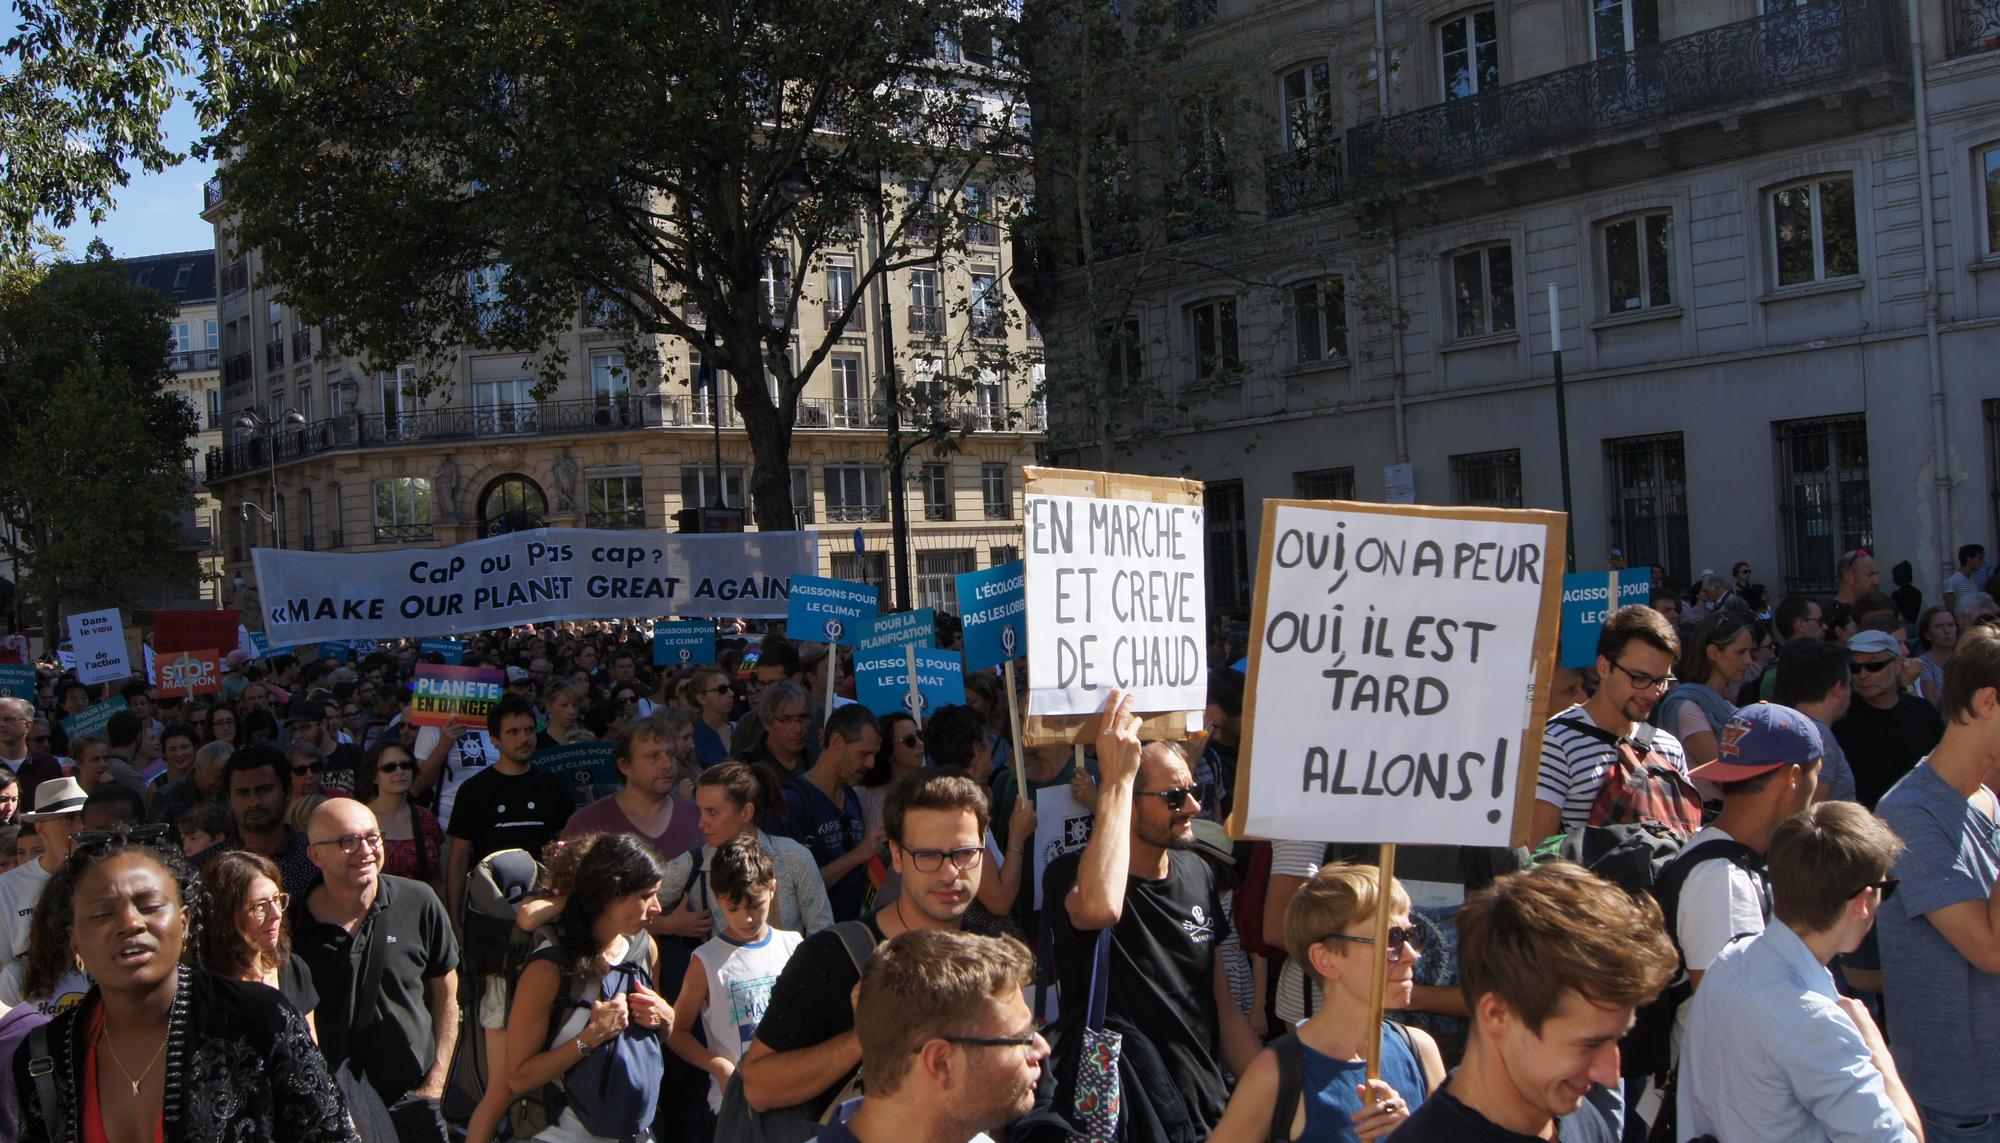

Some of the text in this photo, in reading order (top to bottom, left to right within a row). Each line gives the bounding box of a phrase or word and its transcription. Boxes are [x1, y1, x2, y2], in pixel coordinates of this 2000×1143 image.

[480, 554, 511, 574] ou
[1355, 537, 1406, 577] ON
[1413, 540, 1444, 578] A
[1454, 542, 1541, 584] PEUR
[400, 592, 464, 619] OUR
[474, 576, 573, 611] PLANET
[586, 575, 680, 600] GREAT
[694, 576, 790, 601] AGAIN
[790, 584, 877, 605] AGISSONS POUR
[975, 575, 1024, 600] L'ÉCOLOGIE
[1056, 568, 1195, 624] ET CREVE
[1563, 583, 1649, 602] AGISSOS POUR
[806, 602, 861, 618] LE CLIMAT
[963, 599, 1024, 627] PAS LES LOBB
[1581, 611, 1596, 624] LE
[82, 616, 108, 627] Dans
[654, 627, 692, 635] AGISSONS
[874, 614, 916, 633] POUR LA
[80, 628, 90, 636] le
[860, 624, 932, 651] PLANIFICATION
[1405, 616, 1498, 664] EST
[665, 638, 704, 646] LE CLIMAT
[84, 658, 121, 670] l'action
[95, 651, 107, 660] de
[1057, 635, 1199, 691] DE CHAUD
[161, 661, 215, 681] STOP
[856, 658, 961, 673] AGISSOS POUR
[417, 678, 499, 699] PLANETE
[878, 675, 945, 687] LE CLMAT
[1322, 669, 1450, 718] TARD
[417, 697, 435, 712] EN
[566, 759, 606, 769] CLIMAT
[1302, 738, 1508, 824] ALLONS!
